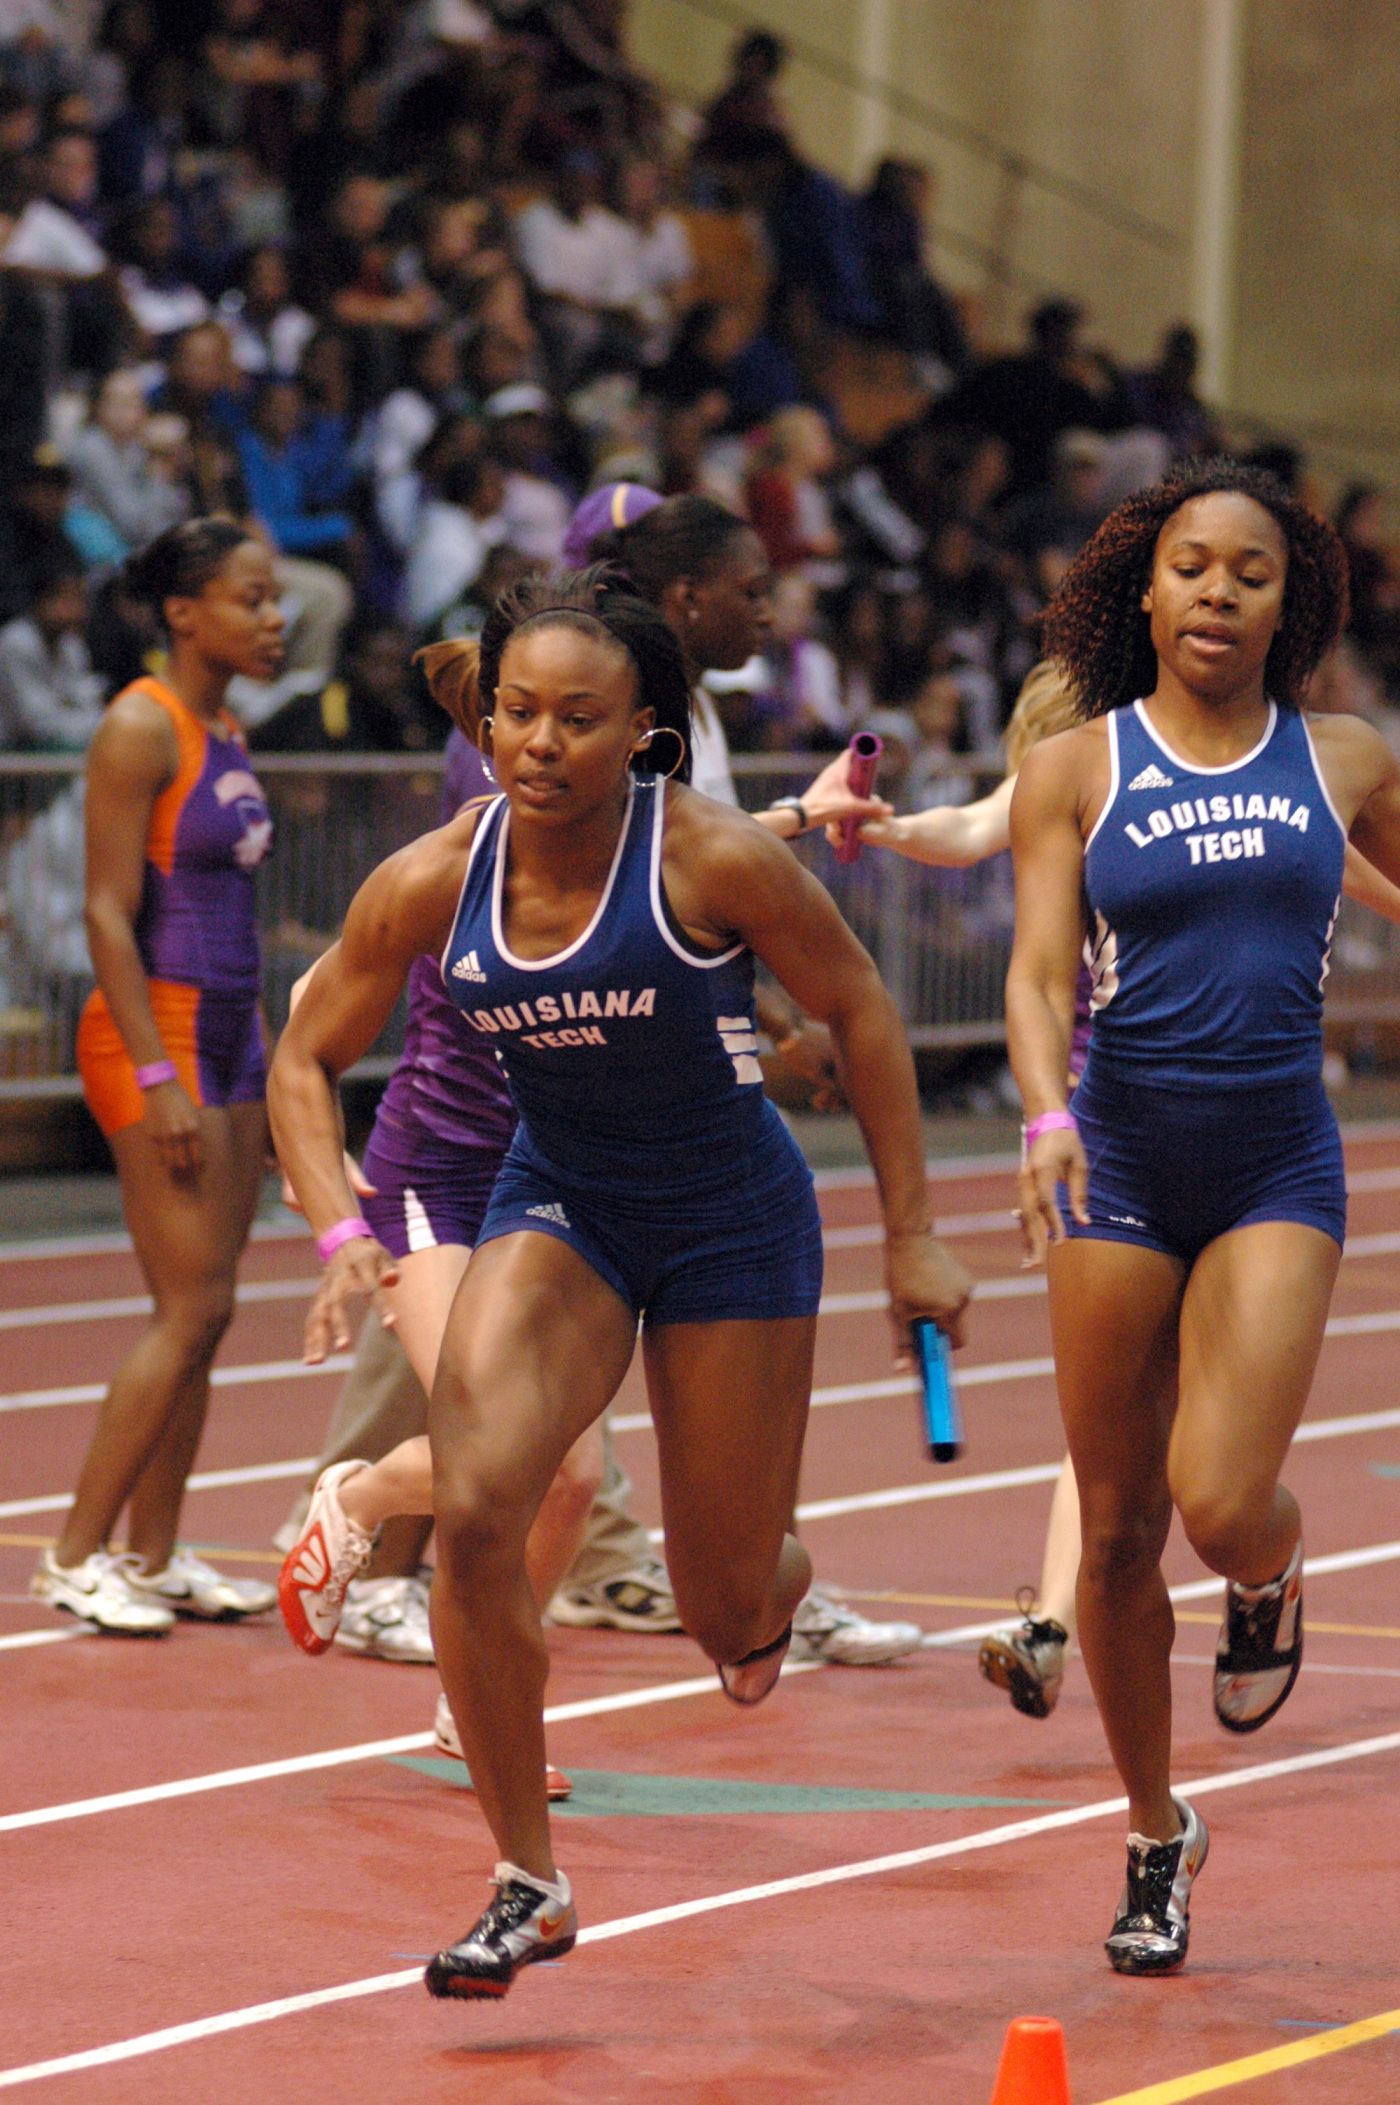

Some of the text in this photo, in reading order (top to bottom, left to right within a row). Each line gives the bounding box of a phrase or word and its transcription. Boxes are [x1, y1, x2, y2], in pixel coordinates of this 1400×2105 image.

[1124, 794, 1310, 848] LOUISIANA
[1185, 827, 1266, 865] TECH
[452, 966, 487, 984] adidas
[460, 988, 656, 1032] LOUISIANA
[520, 1025, 607, 1049] TECH
[525, 1207, 571, 1229] adidas
